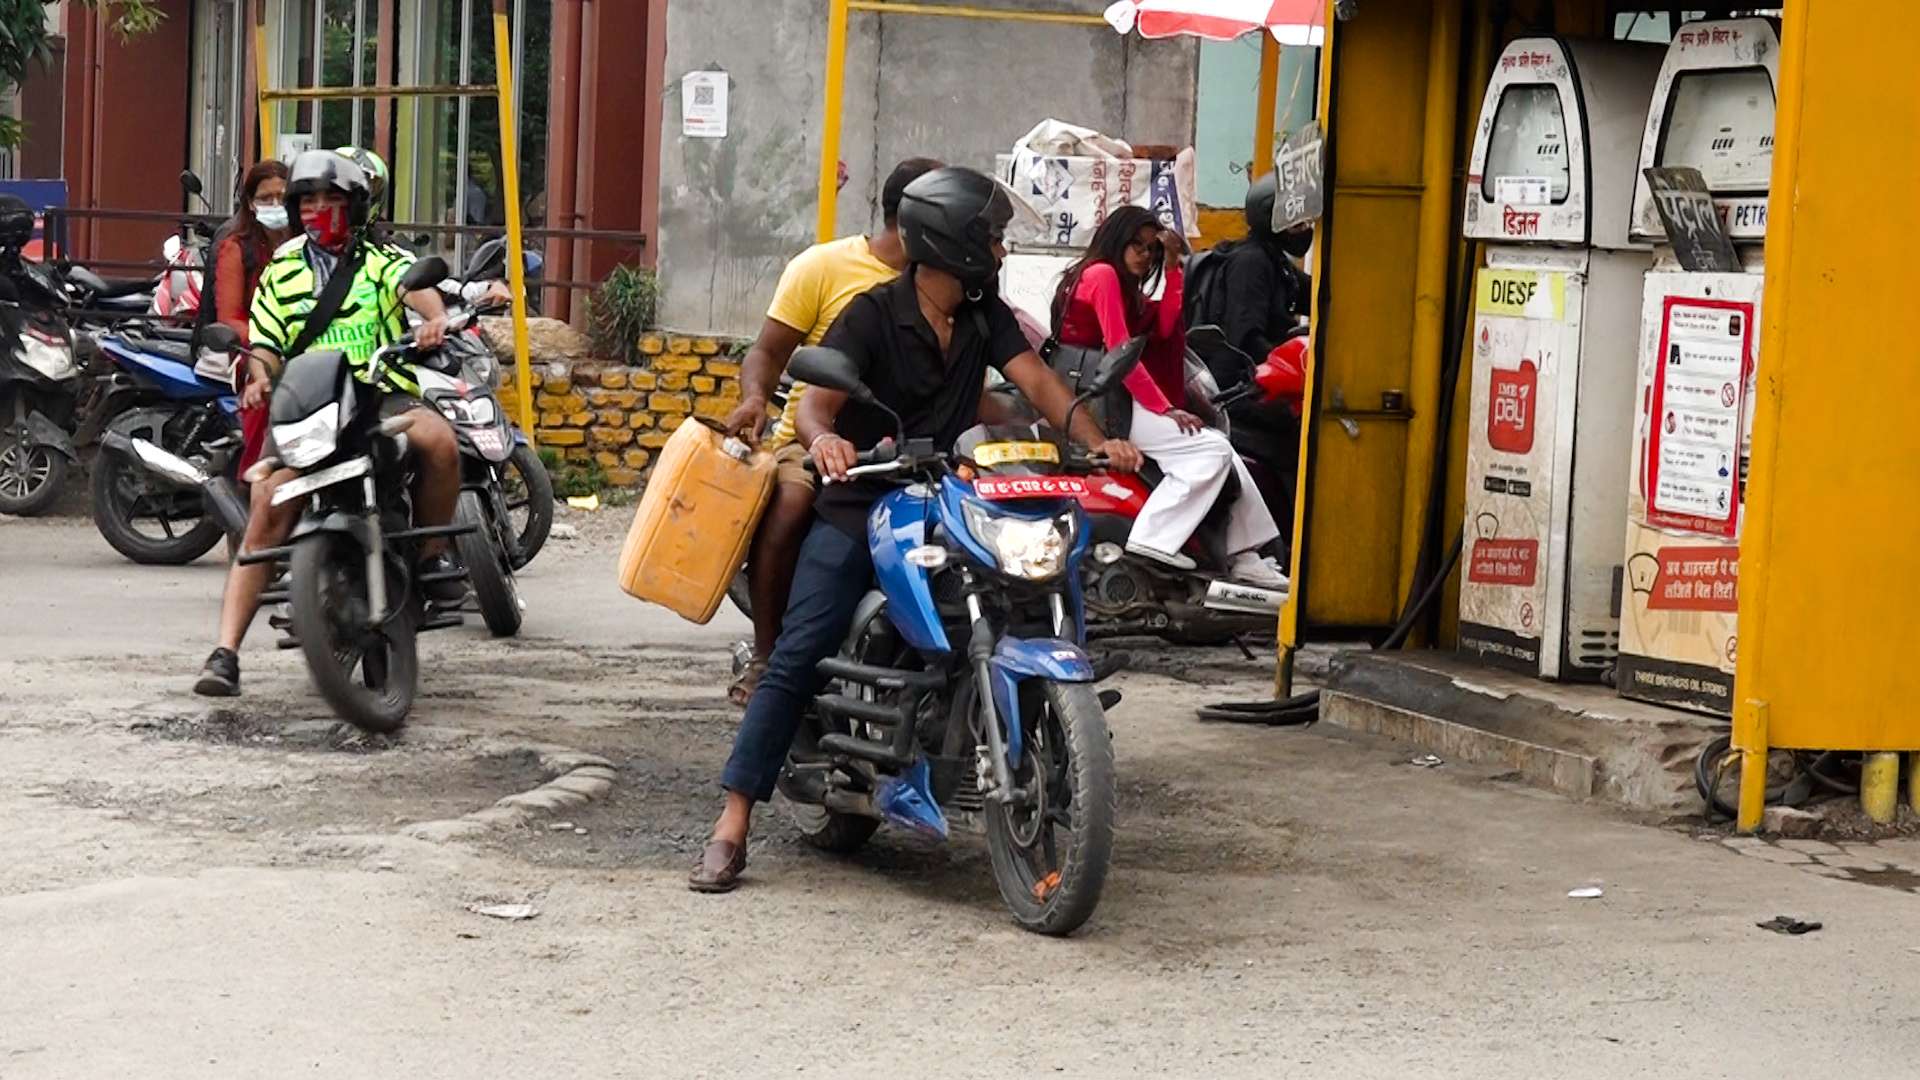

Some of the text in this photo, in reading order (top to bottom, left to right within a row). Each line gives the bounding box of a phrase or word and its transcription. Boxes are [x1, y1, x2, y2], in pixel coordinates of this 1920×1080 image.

[1735, 204, 1767, 226] PETR
[1491, 279, 1537, 305] DIESE
[320, 322, 375, 346] mirate
[1493, 397, 1527, 431] pay
[1701, 681, 1728, 697] STORES
